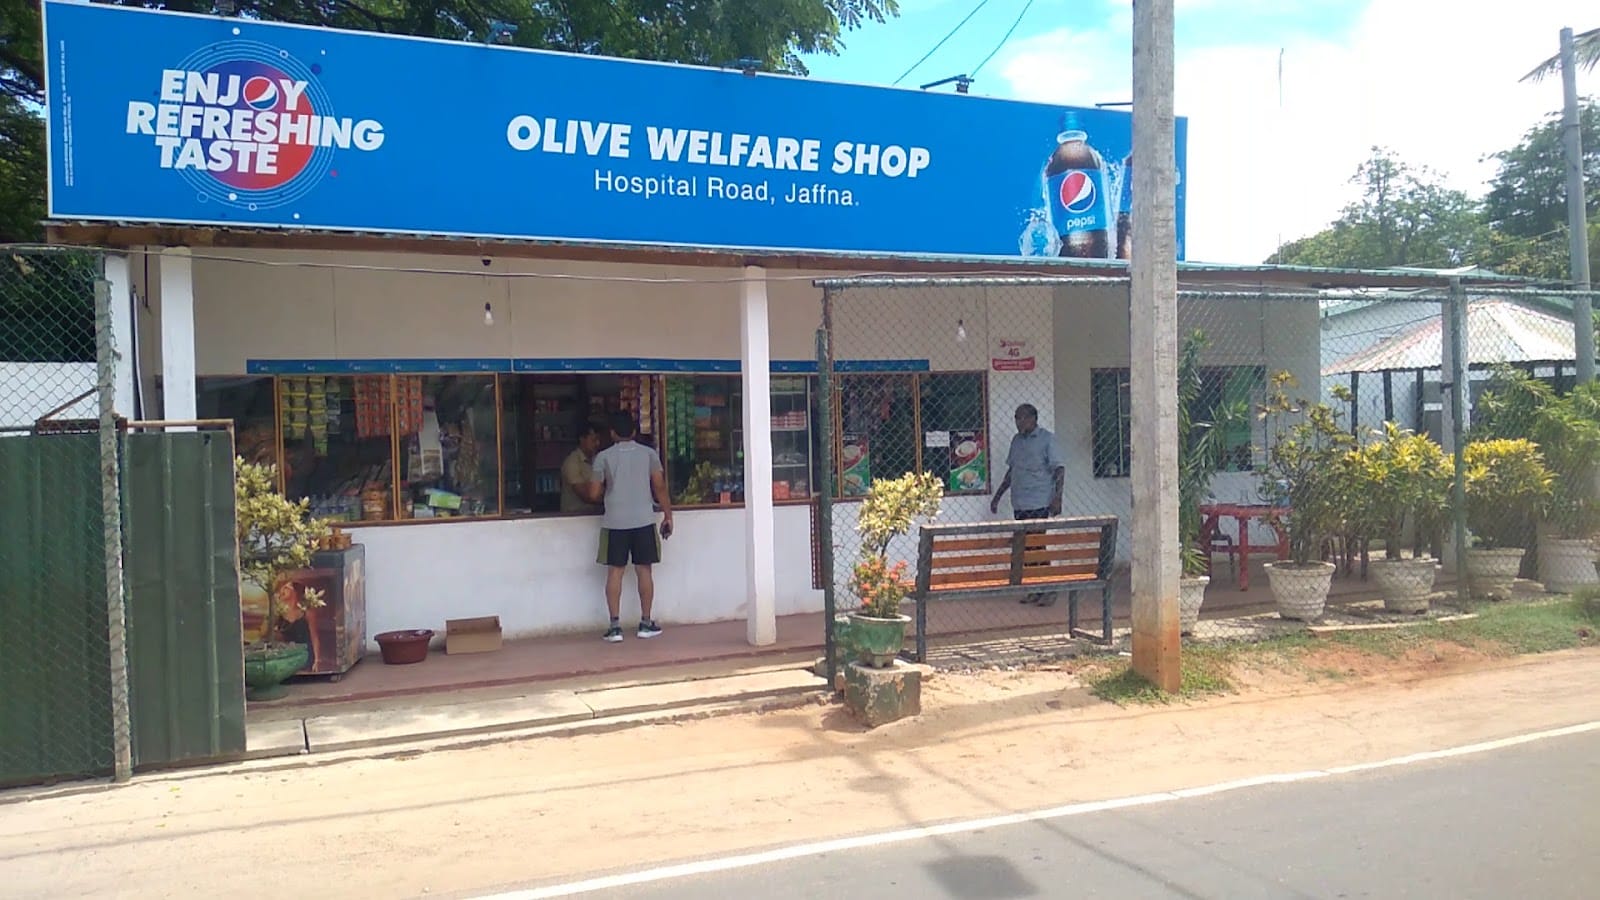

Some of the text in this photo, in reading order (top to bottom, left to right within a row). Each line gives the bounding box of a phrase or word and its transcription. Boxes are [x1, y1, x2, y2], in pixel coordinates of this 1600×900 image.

[160, 69, 308, 111] ENJOY
[127, 102, 385, 151] REFRESHING
[155, 136, 279, 175] TASTE
[506, 114, 930, 179] OLIVE WELFARE SHOP
[594, 169, 860, 206] Hospital Road, Jaffna.
[1066, 215, 1096, 230] pepsi
[1008, 347, 1020, 357] 4G
